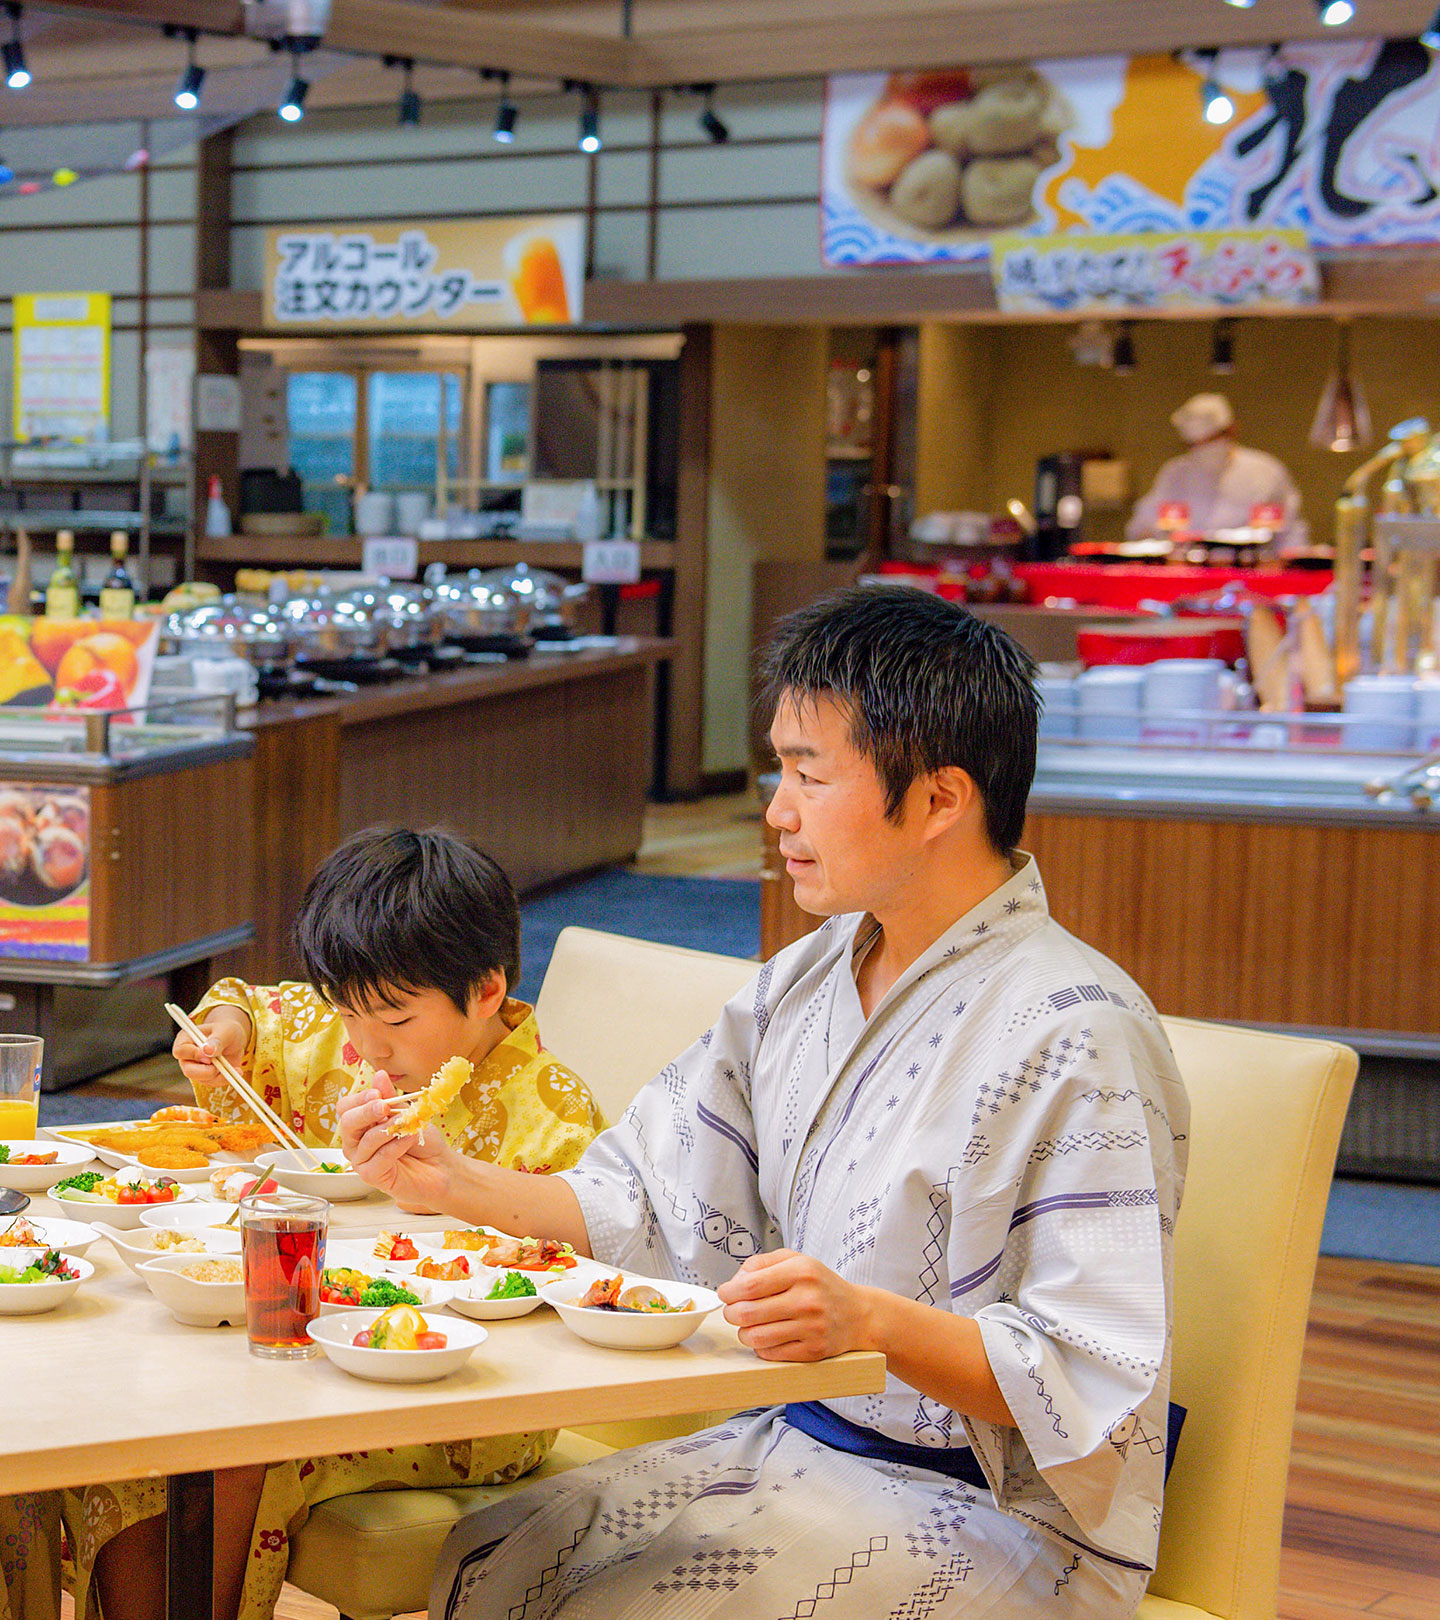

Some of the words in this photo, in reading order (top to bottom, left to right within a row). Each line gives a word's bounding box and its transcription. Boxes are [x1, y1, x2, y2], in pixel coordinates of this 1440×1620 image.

[1235, 38, 1438, 220] 北
[282, 237, 432, 273] アルコール
[278, 276, 501, 313] 注文カウンター
